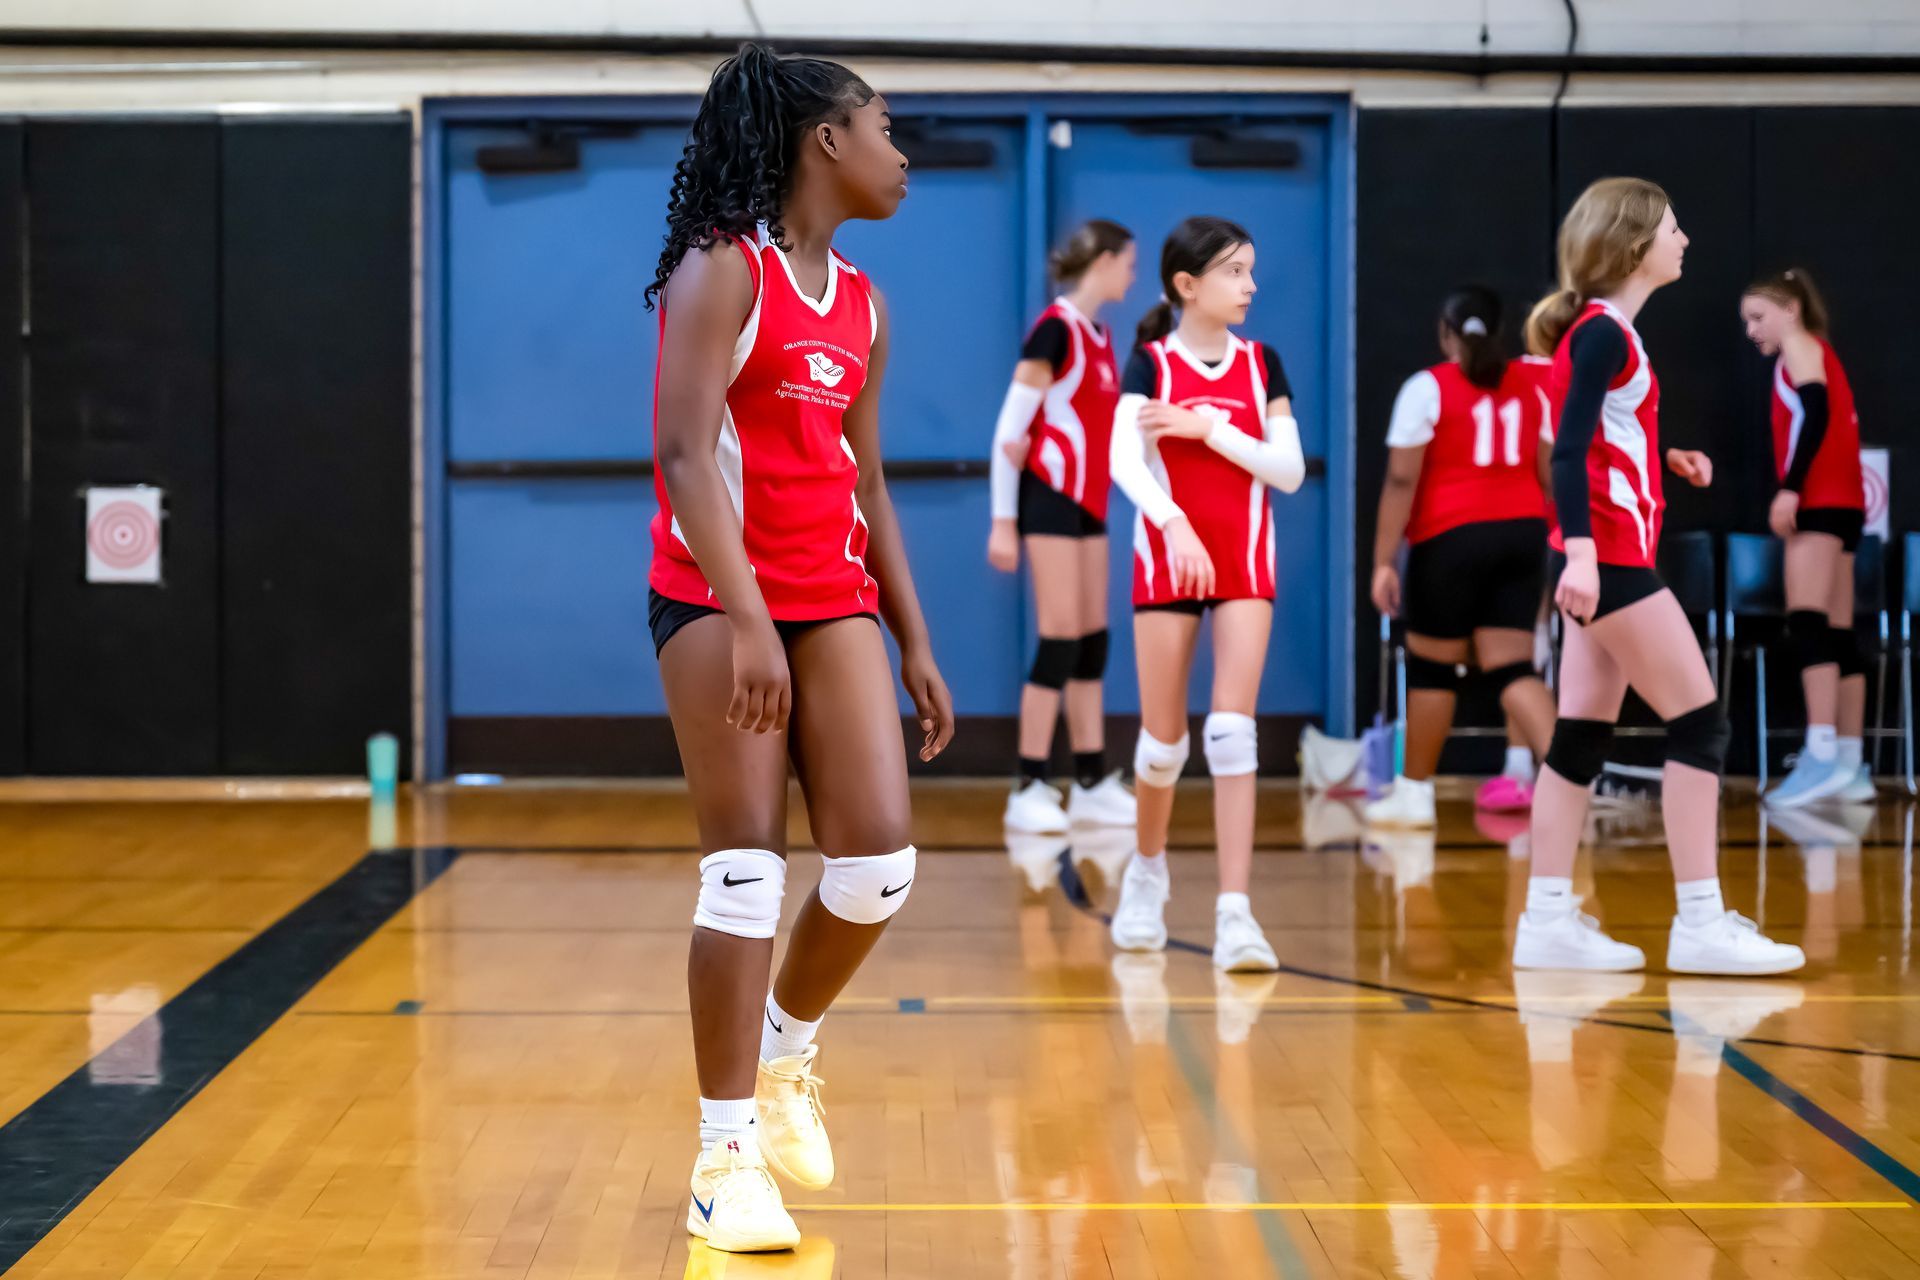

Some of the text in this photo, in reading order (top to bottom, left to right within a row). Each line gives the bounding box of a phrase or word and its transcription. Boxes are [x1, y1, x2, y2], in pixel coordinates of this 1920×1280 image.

[783, 340, 808, 350] ORANGE
[808, 340, 827, 348] COUNTY
[827, 343, 846, 355] YOUTH
[781, 380, 814, 393] Department
[814, 387, 821, 396] of
[1472, 393, 1522, 467] 11
